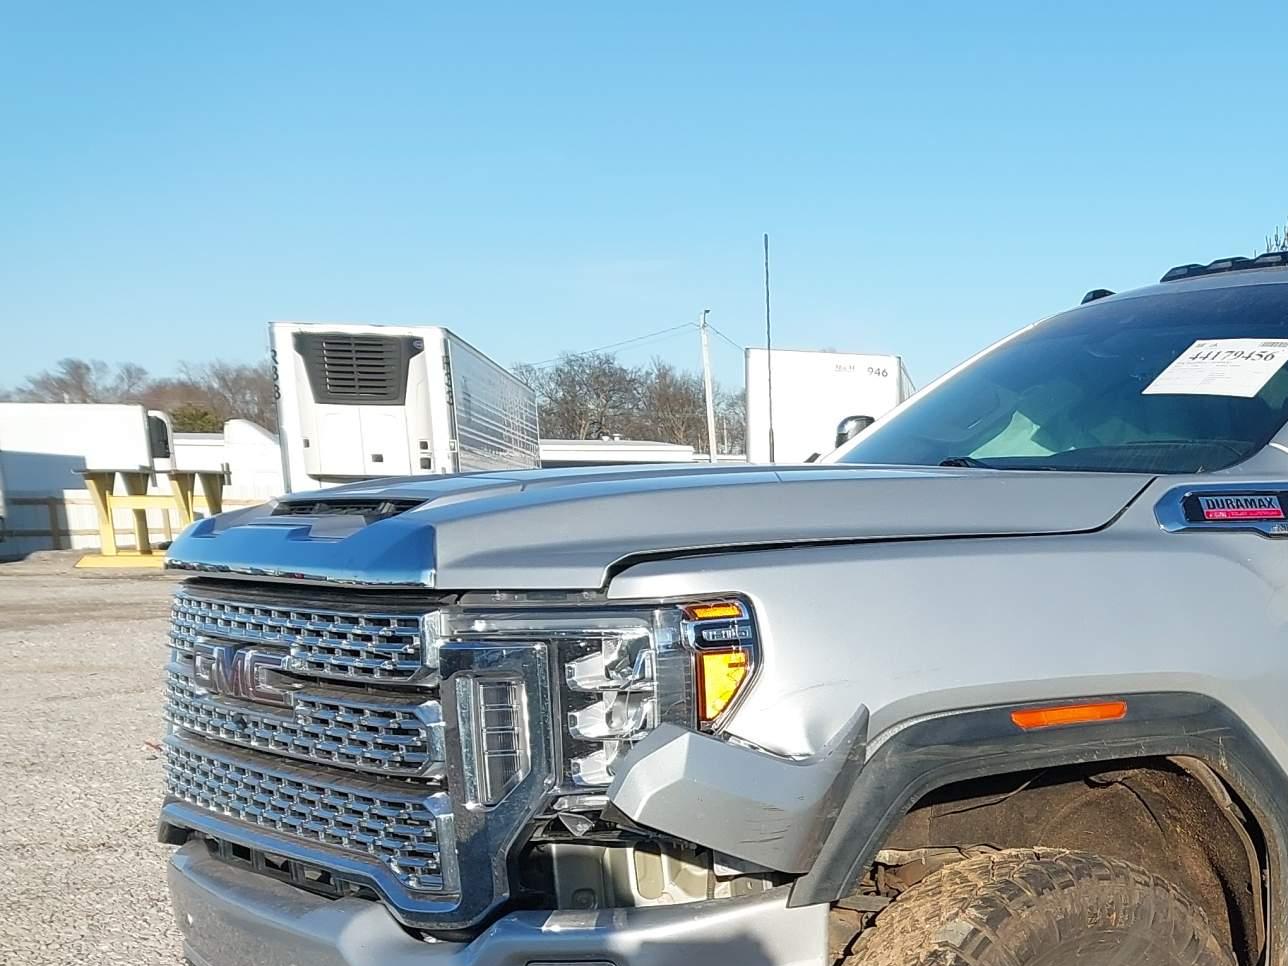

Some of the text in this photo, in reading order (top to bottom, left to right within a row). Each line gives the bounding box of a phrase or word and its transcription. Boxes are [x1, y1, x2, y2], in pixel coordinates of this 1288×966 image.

[1188, 350, 1279, 362] 44179456
[867, 366, 889, 378] 946
[1206, 497, 1277, 510] DURAMAX
[194, 641, 296, 710] GMC
